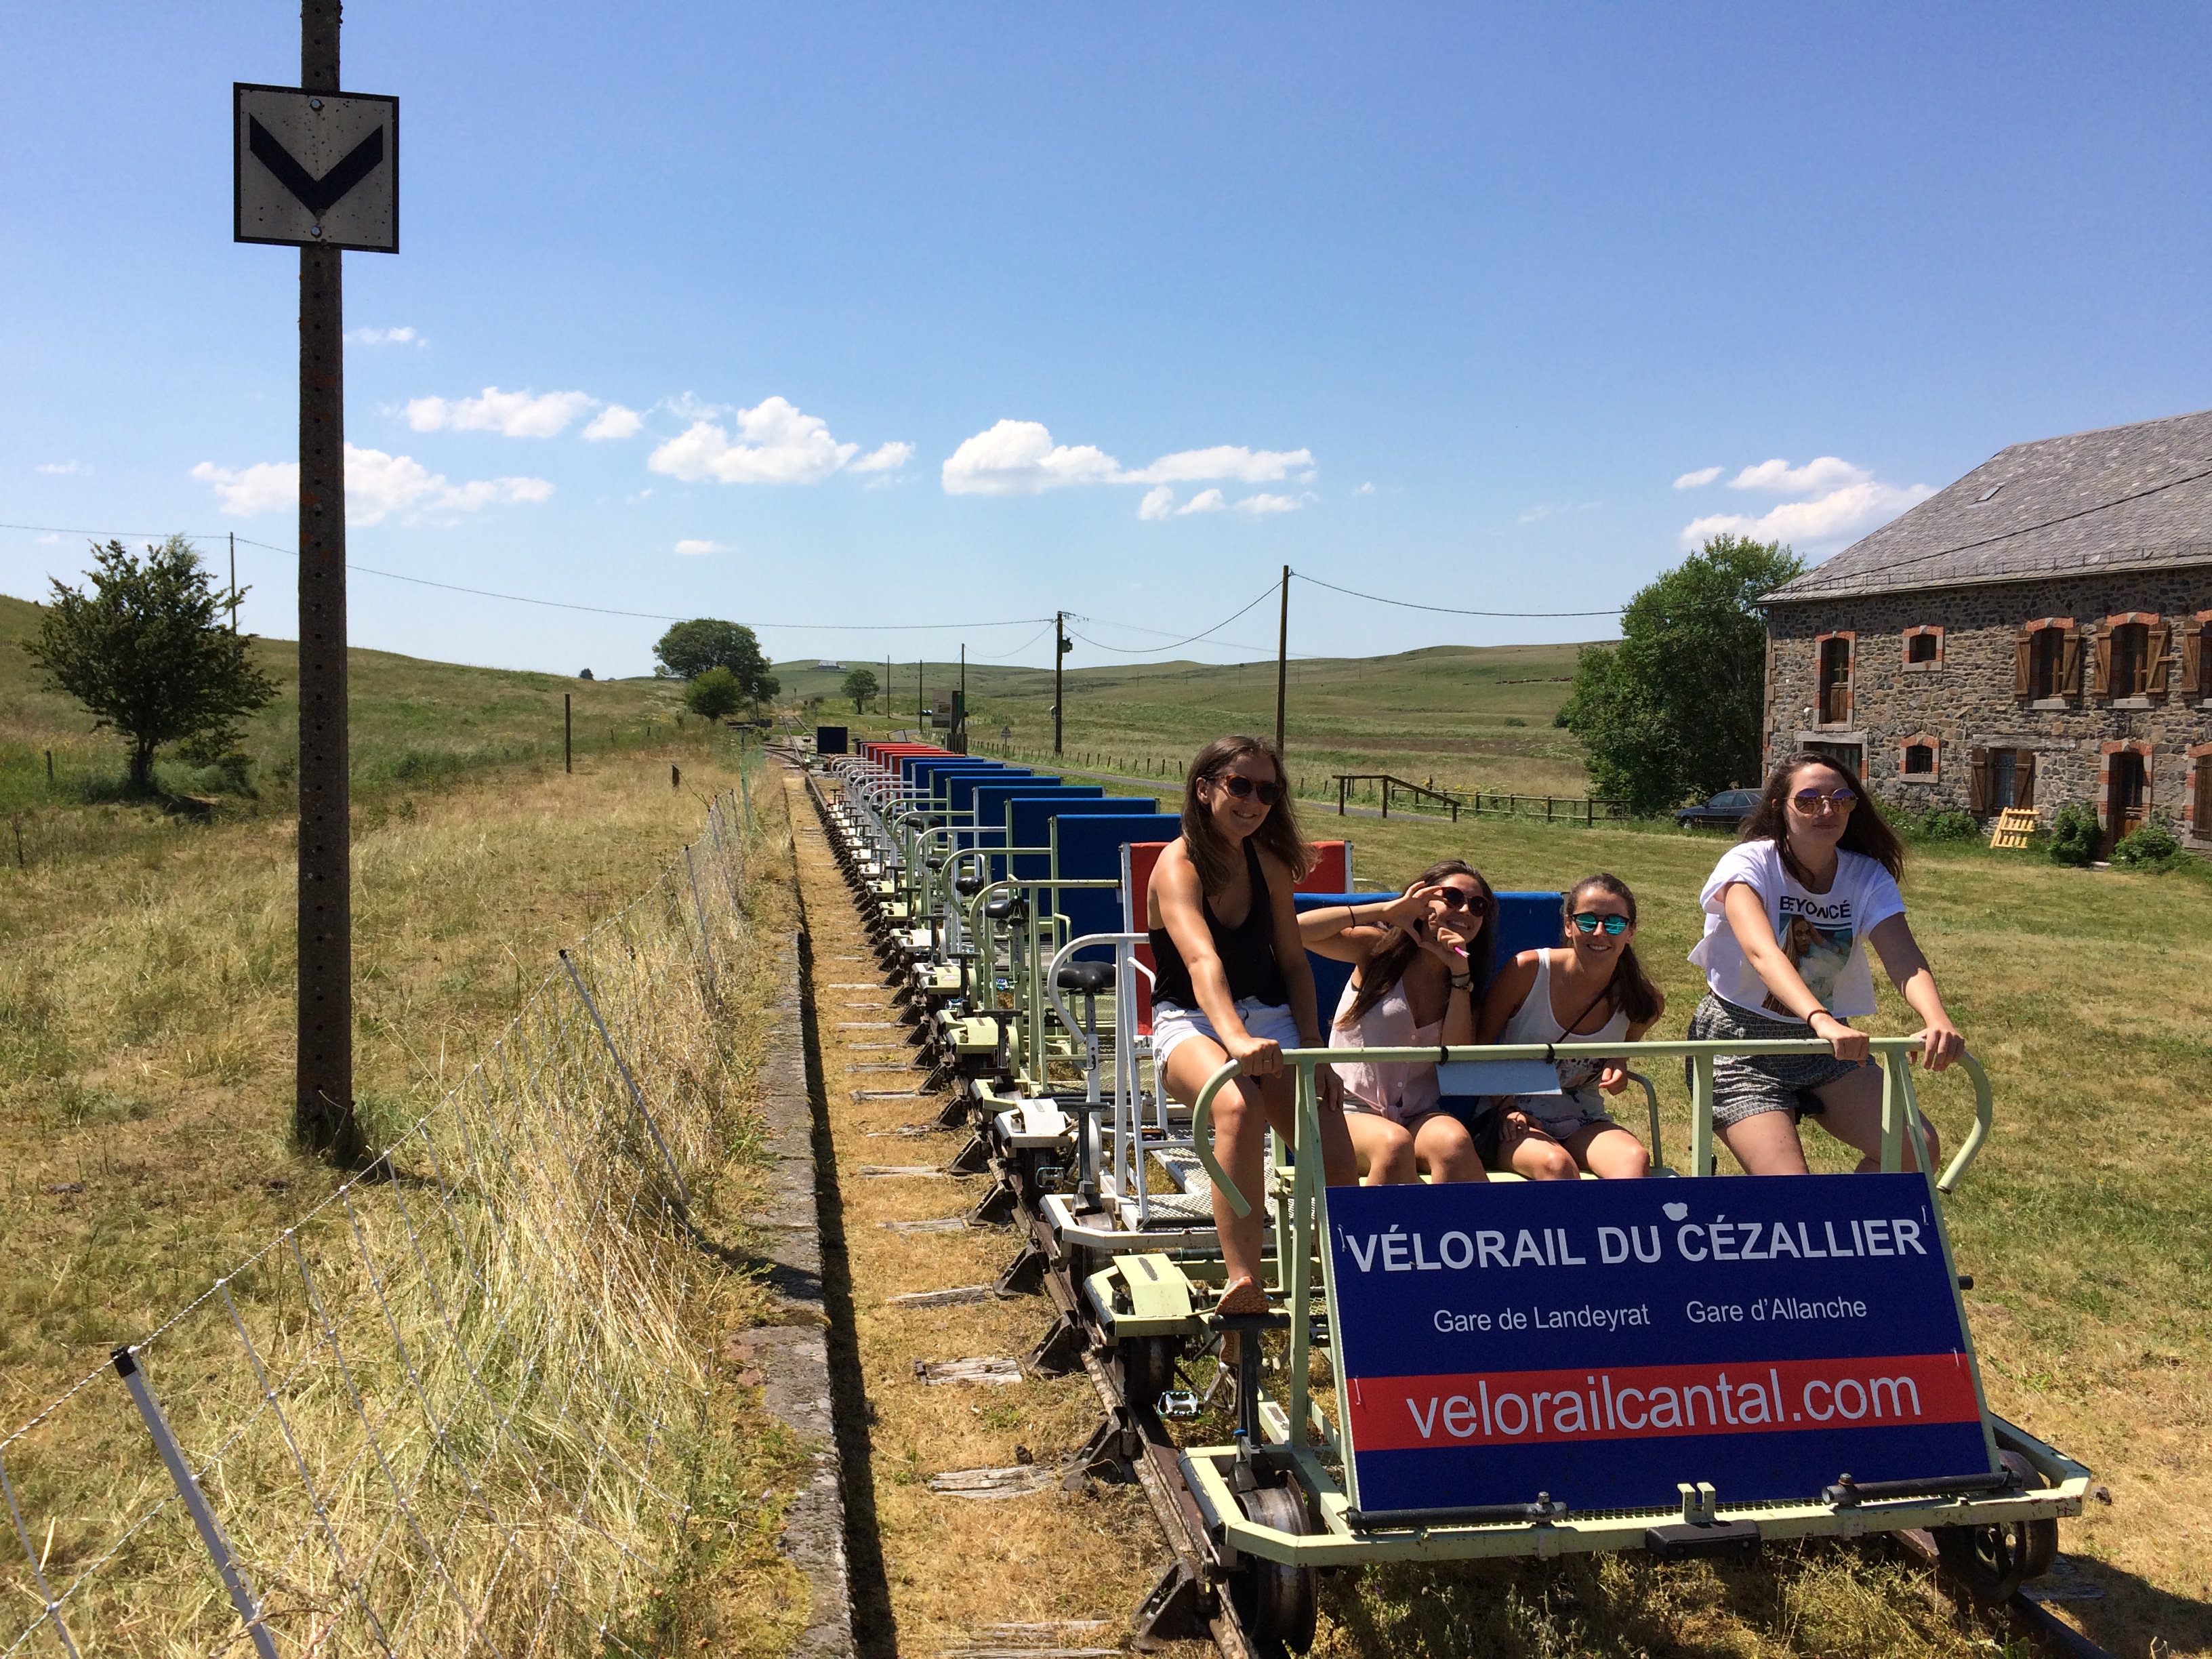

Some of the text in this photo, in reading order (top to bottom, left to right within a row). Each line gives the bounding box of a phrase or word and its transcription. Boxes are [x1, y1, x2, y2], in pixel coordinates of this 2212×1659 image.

[752, 682, 759, 693] S
[1345, 1214, 1928, 1272] VÉLORAIL DU CÉZALLIER
[1433, 1303, 1651, 1333] Gare de Landeyrat
[1685, 1300, 1744, 1324] Gare
[1406, 1368, 1922, 1437] velorailcantal.com
